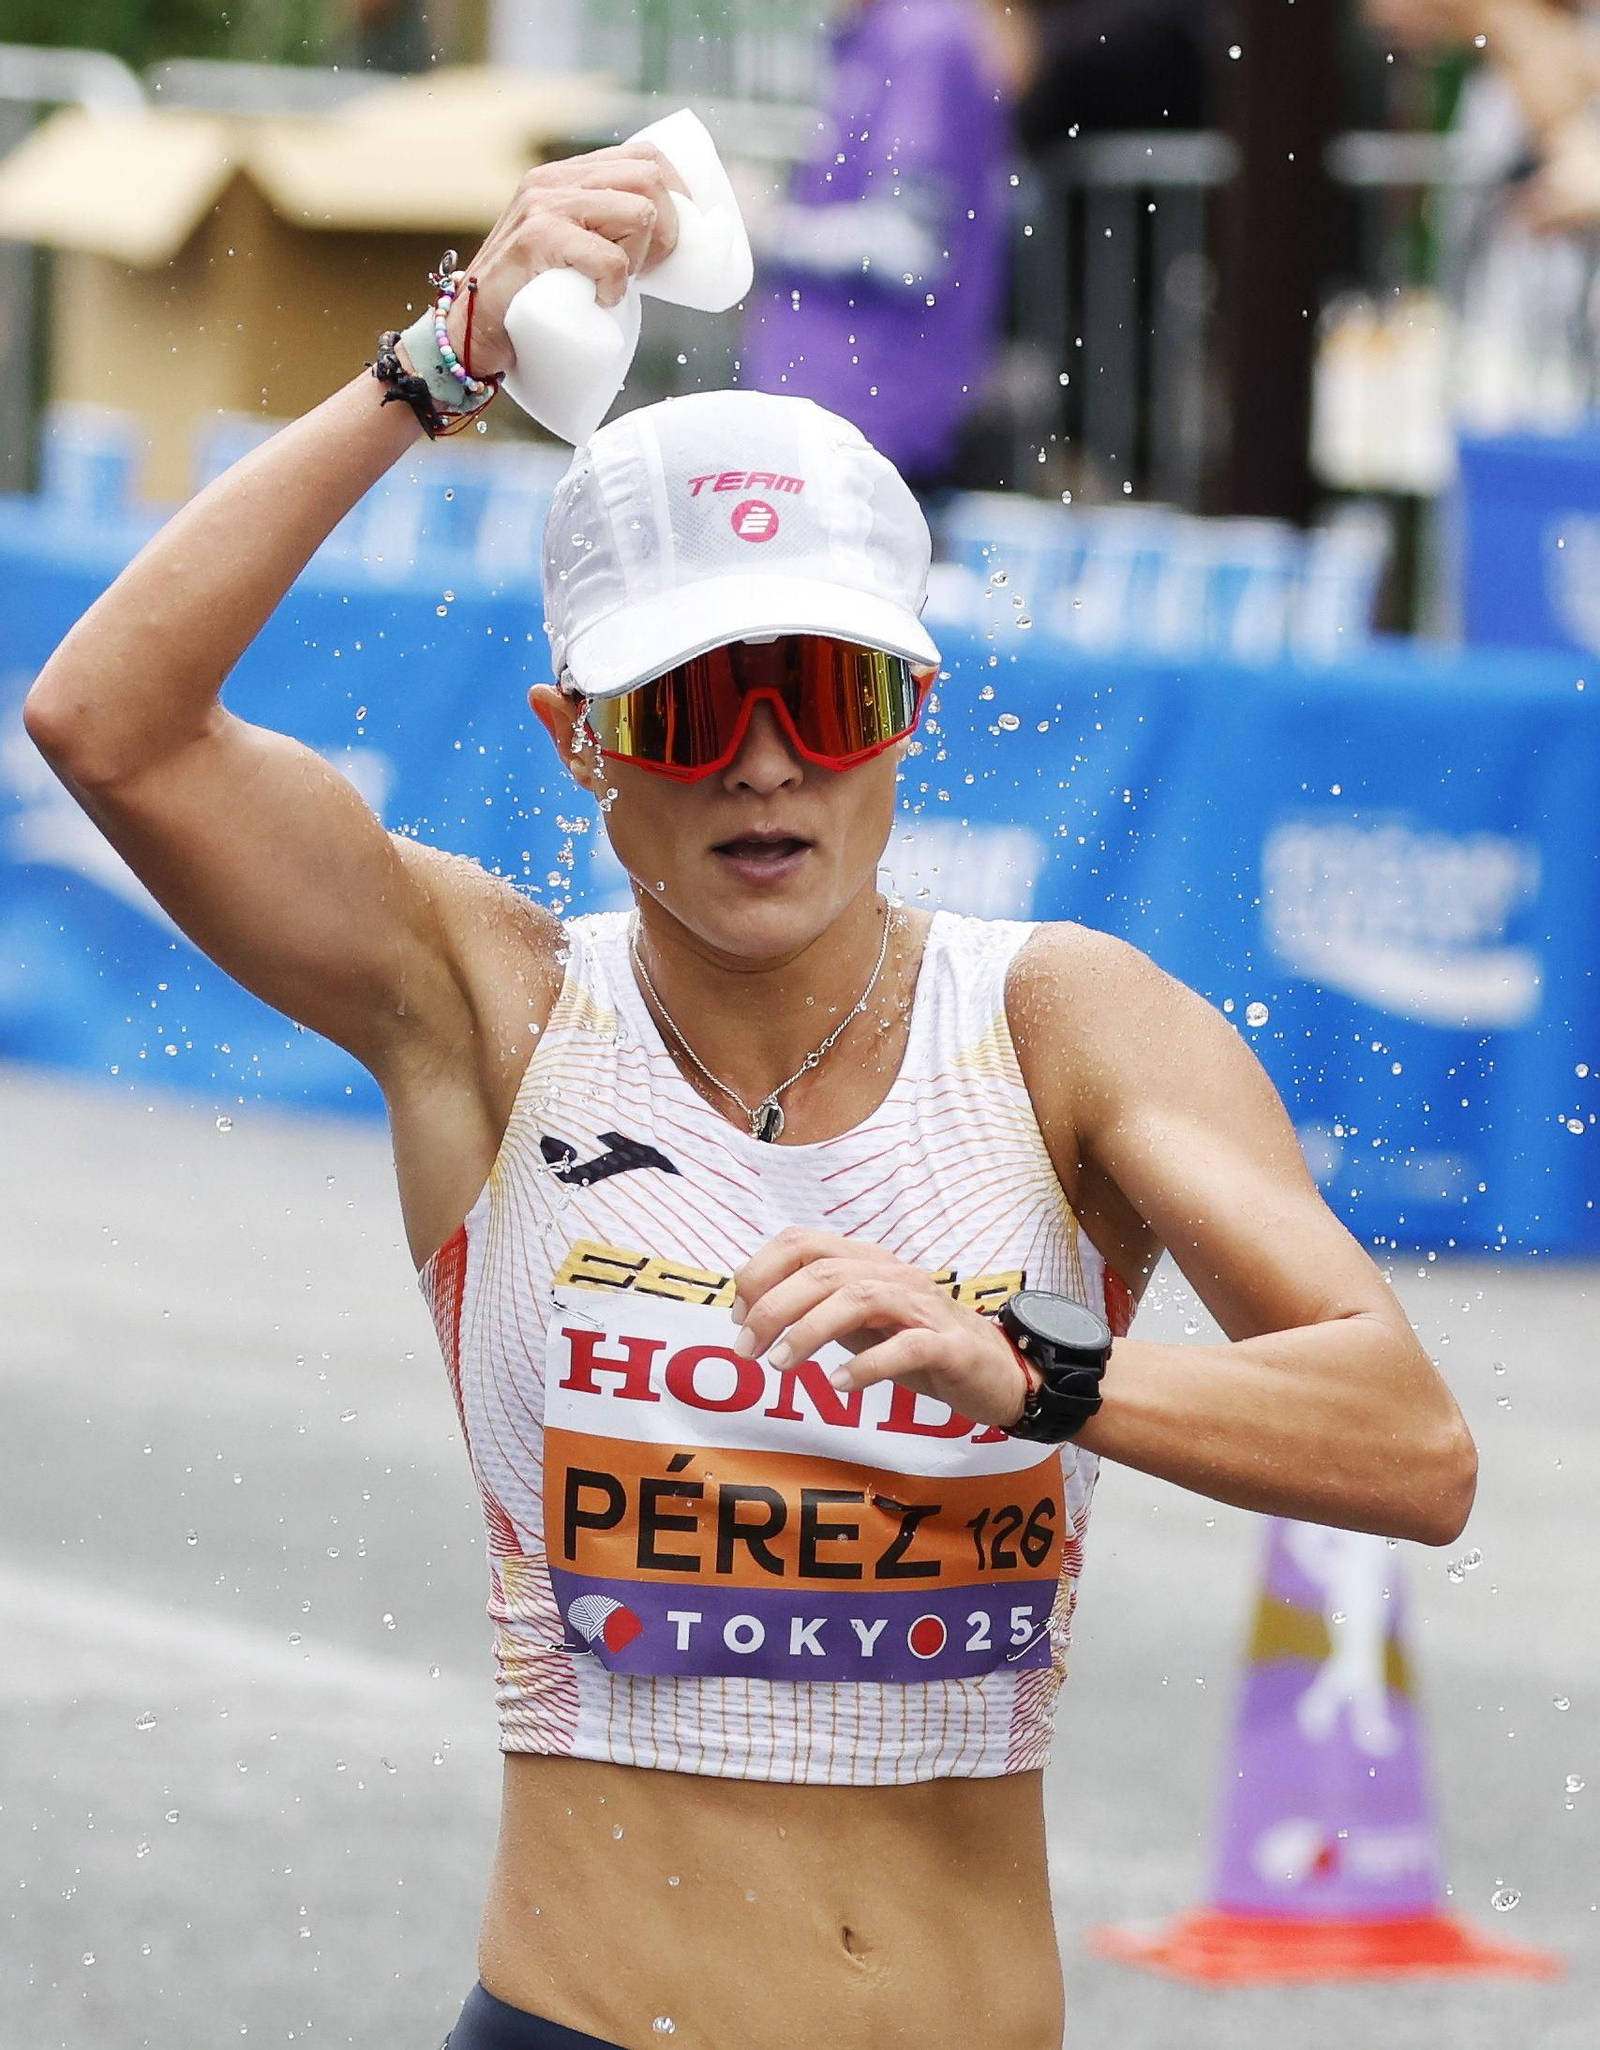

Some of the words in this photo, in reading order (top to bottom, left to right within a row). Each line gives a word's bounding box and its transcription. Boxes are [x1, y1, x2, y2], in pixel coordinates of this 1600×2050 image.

[688, 471, 805, 497] TEAM
[564, 1454, 942, 1580] PÉREZ
[965, 1497, 1056, 1571] 126
